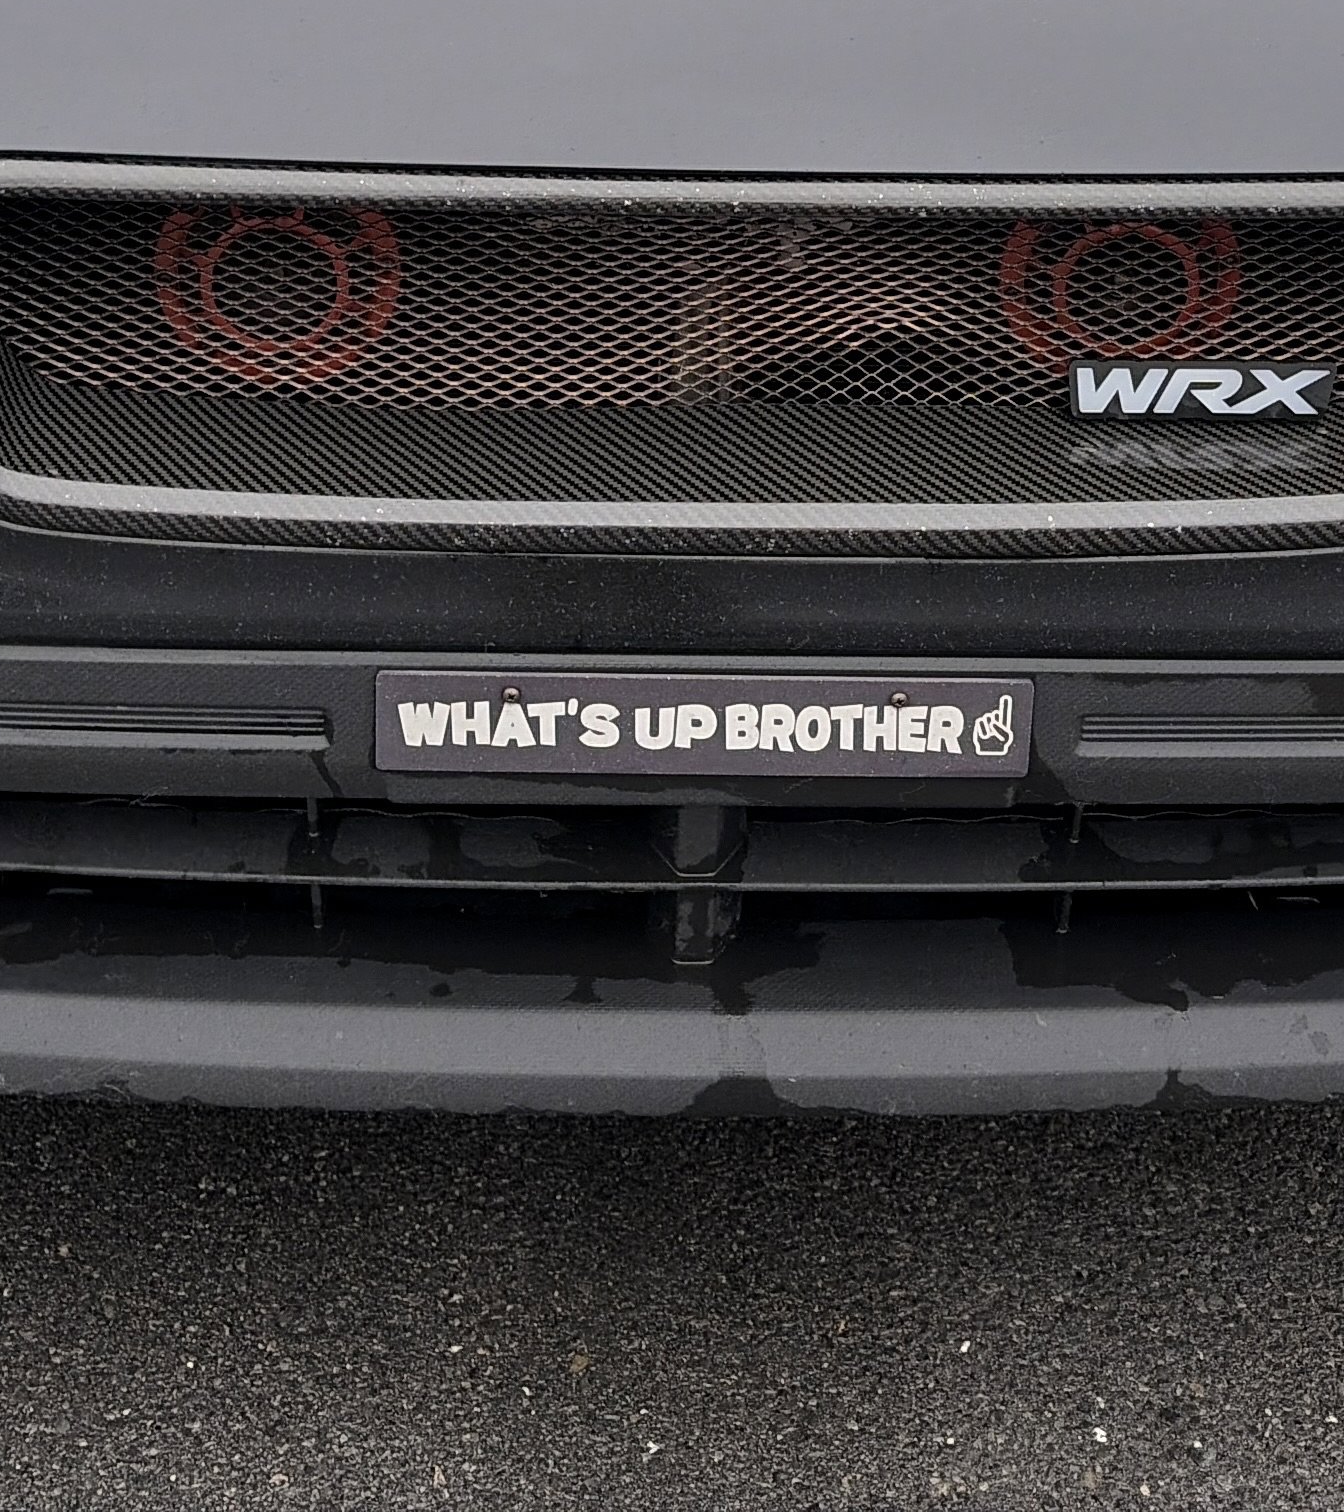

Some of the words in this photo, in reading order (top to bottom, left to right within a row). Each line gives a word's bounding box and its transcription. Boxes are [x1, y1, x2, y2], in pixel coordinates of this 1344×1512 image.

[1076, 367, 1332, 416] WRX
[397, 698, 622, 749] WHAT'S
[634, 705, 718, 752] UP
[725, 703, 964, 755] BROTHER
